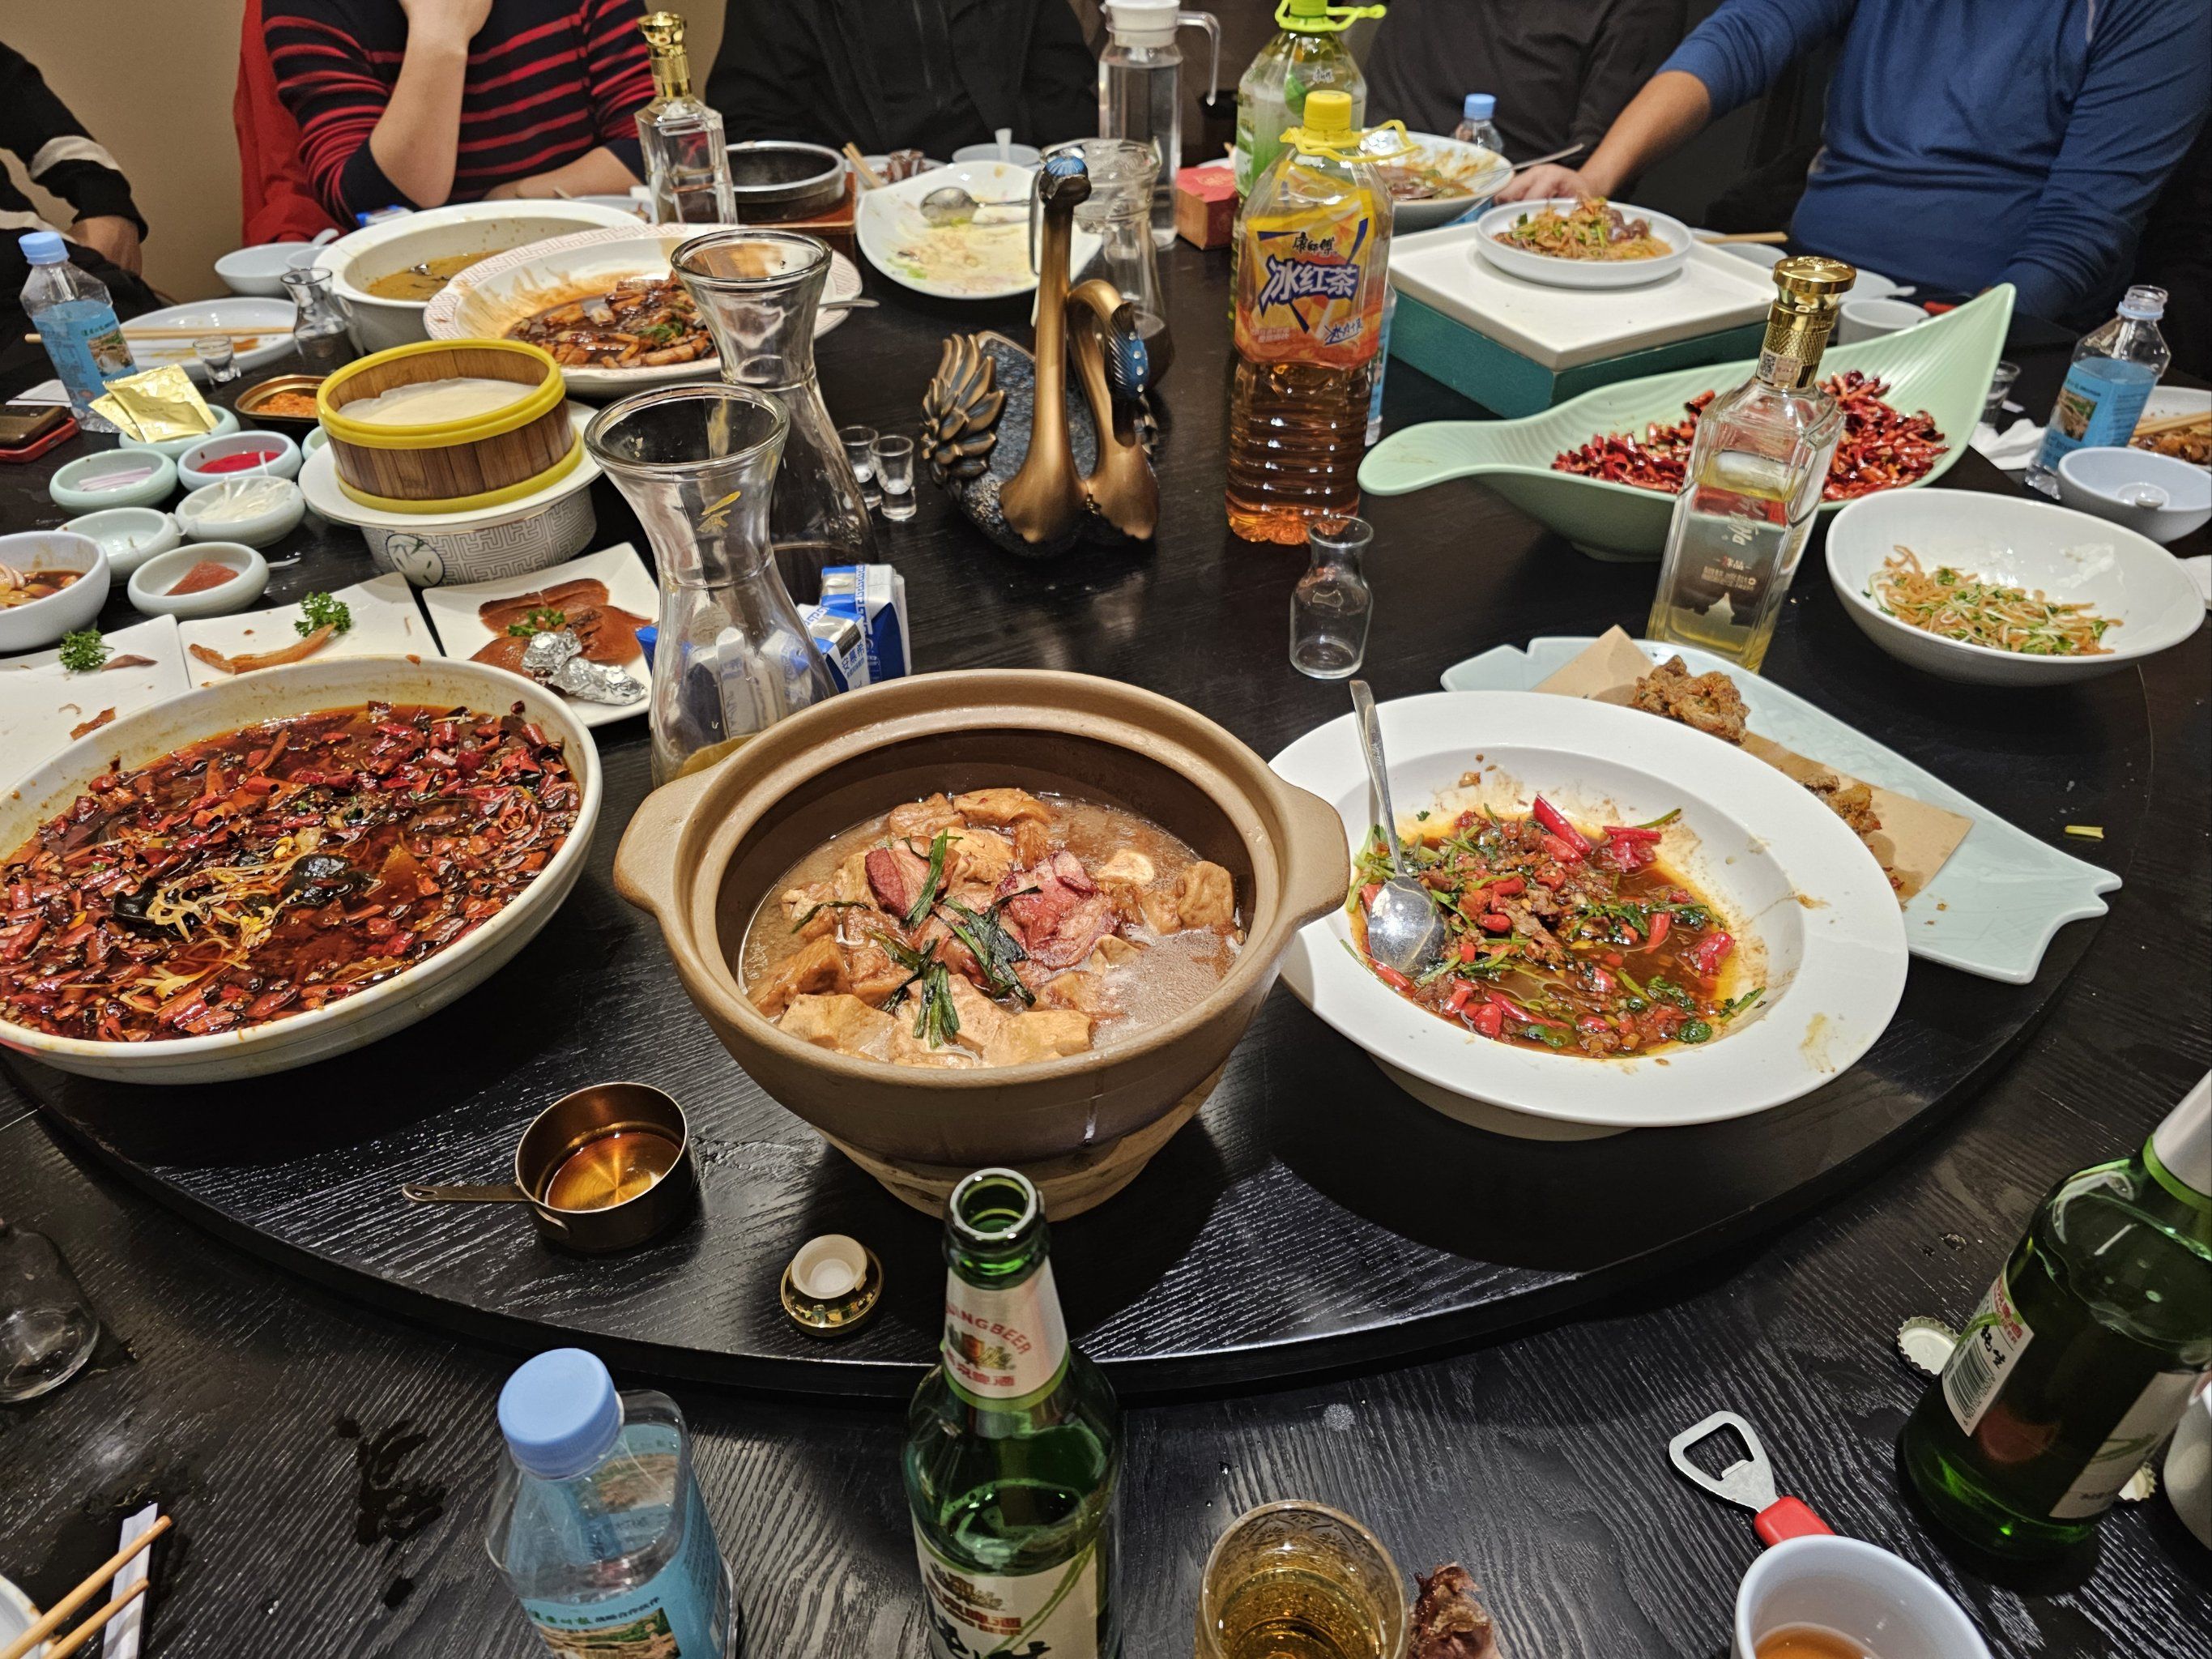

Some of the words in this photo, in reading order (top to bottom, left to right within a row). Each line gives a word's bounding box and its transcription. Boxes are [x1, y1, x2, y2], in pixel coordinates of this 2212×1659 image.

[1259, 256, 1359, 309] 冰红茶
[842, 642, 864, 673] 安慕希
